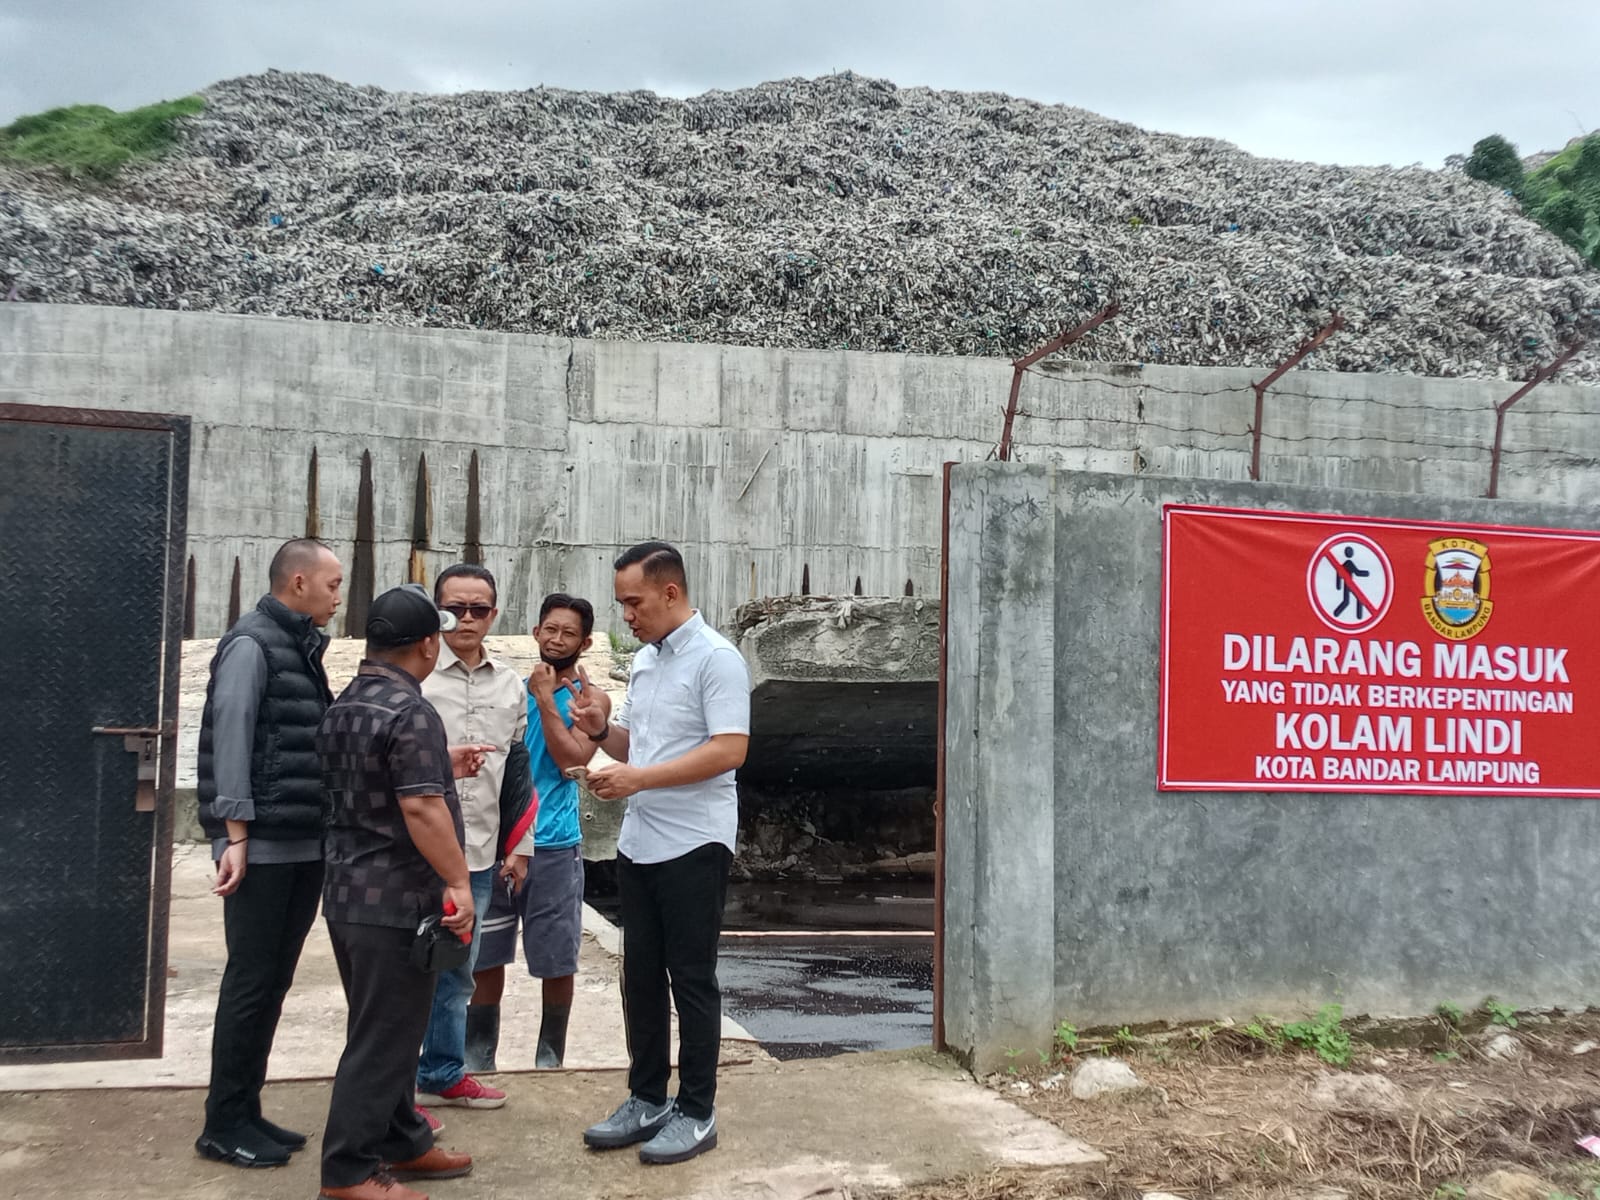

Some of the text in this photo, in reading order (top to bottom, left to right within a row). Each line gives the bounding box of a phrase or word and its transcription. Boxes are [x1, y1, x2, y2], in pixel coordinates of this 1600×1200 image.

[1441, 540, 1475, 551] KOTA
[1424, 603, 1491, 639] BANDAR LAMPUNG
[1223, 633, 1570, 683] DILARANG MASUK
[1221, 679, 1573, 714] YANG TIDAK BERKEPENTINGAN
[1276, 712, 1522, 755] KOLAM LINDI
[1255, 755, 1540, 784] KOTA BANDAR LAMPUNG
